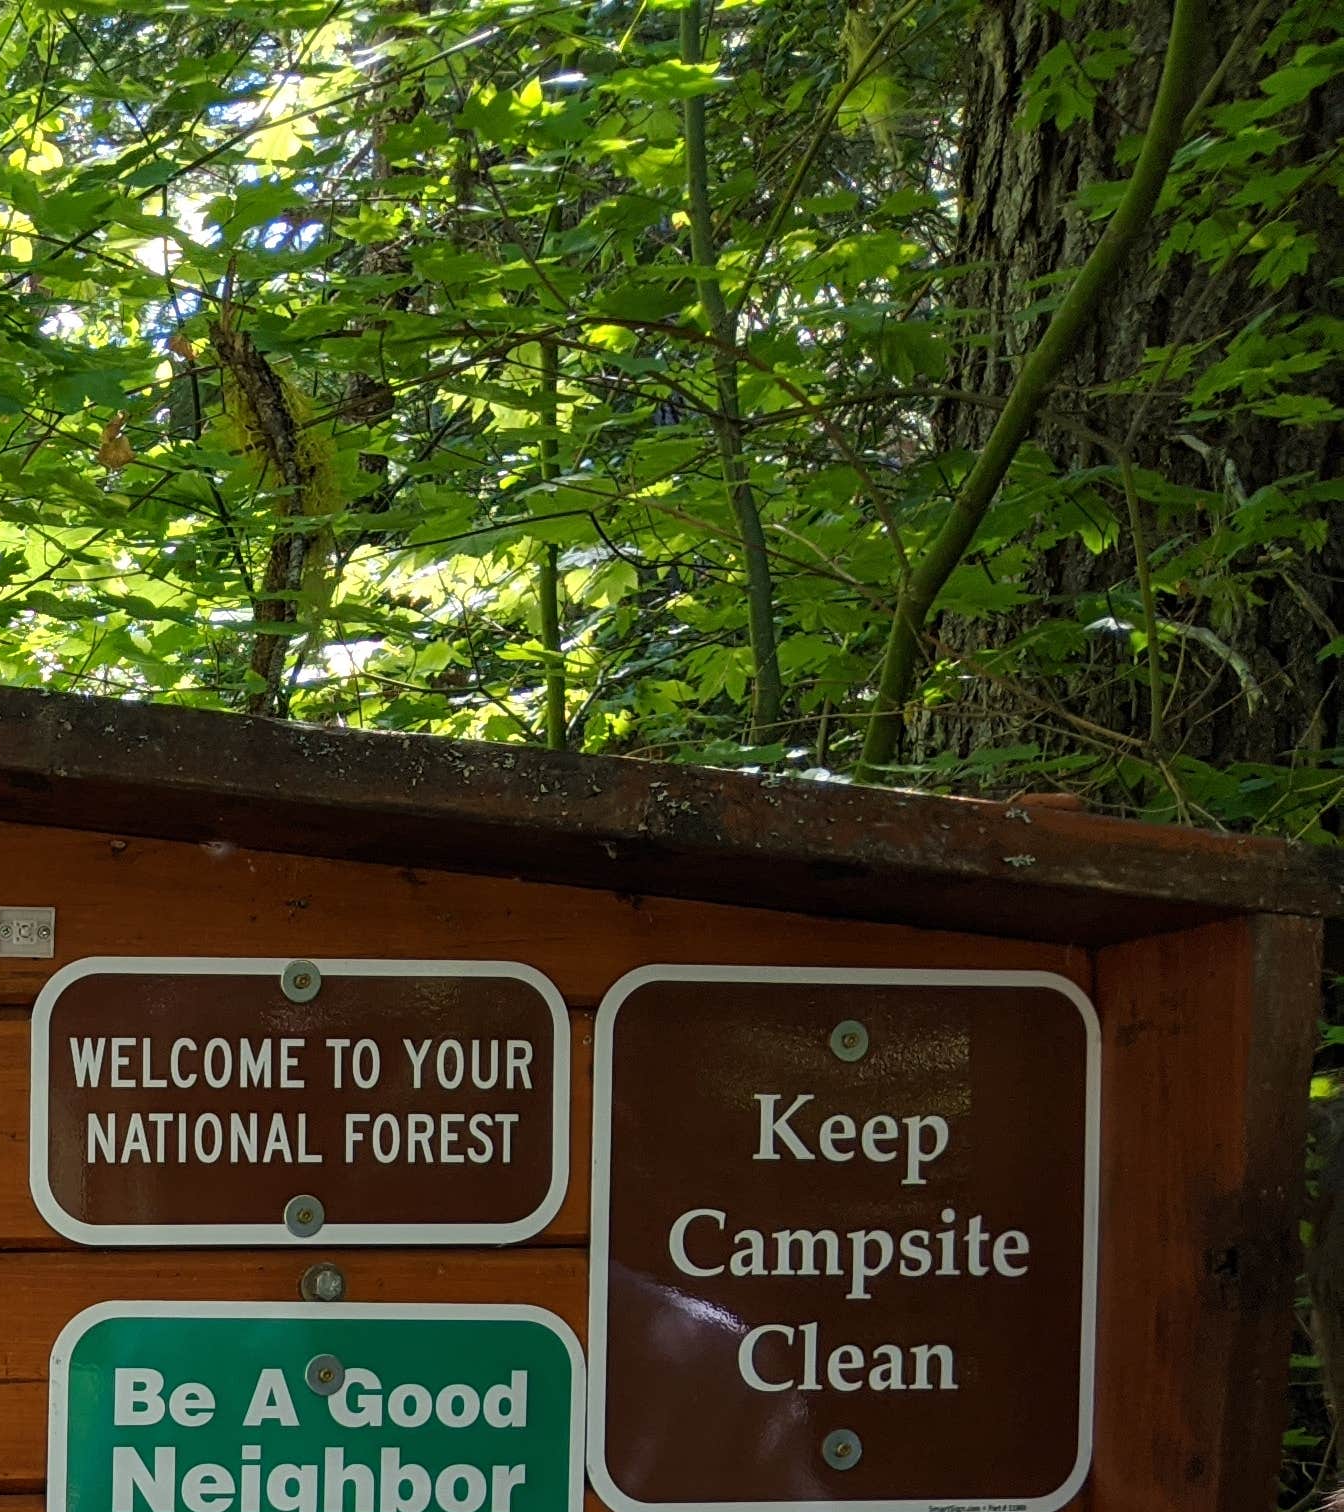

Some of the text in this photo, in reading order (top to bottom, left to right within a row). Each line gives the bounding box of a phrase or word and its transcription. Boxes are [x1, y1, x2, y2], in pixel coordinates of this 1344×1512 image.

[70, 1038, 532, 1089] WELCOME TO YOUR
[88, 1113, 518, 1163] NATIONAL FOREST
[753, 1094, 948, 1184] Keep
[669, 1209, 1029, 1299] Campsite
[739, 1322, 958, 1391] Clean
[114, 1368, 527, 1428] Be A Good
